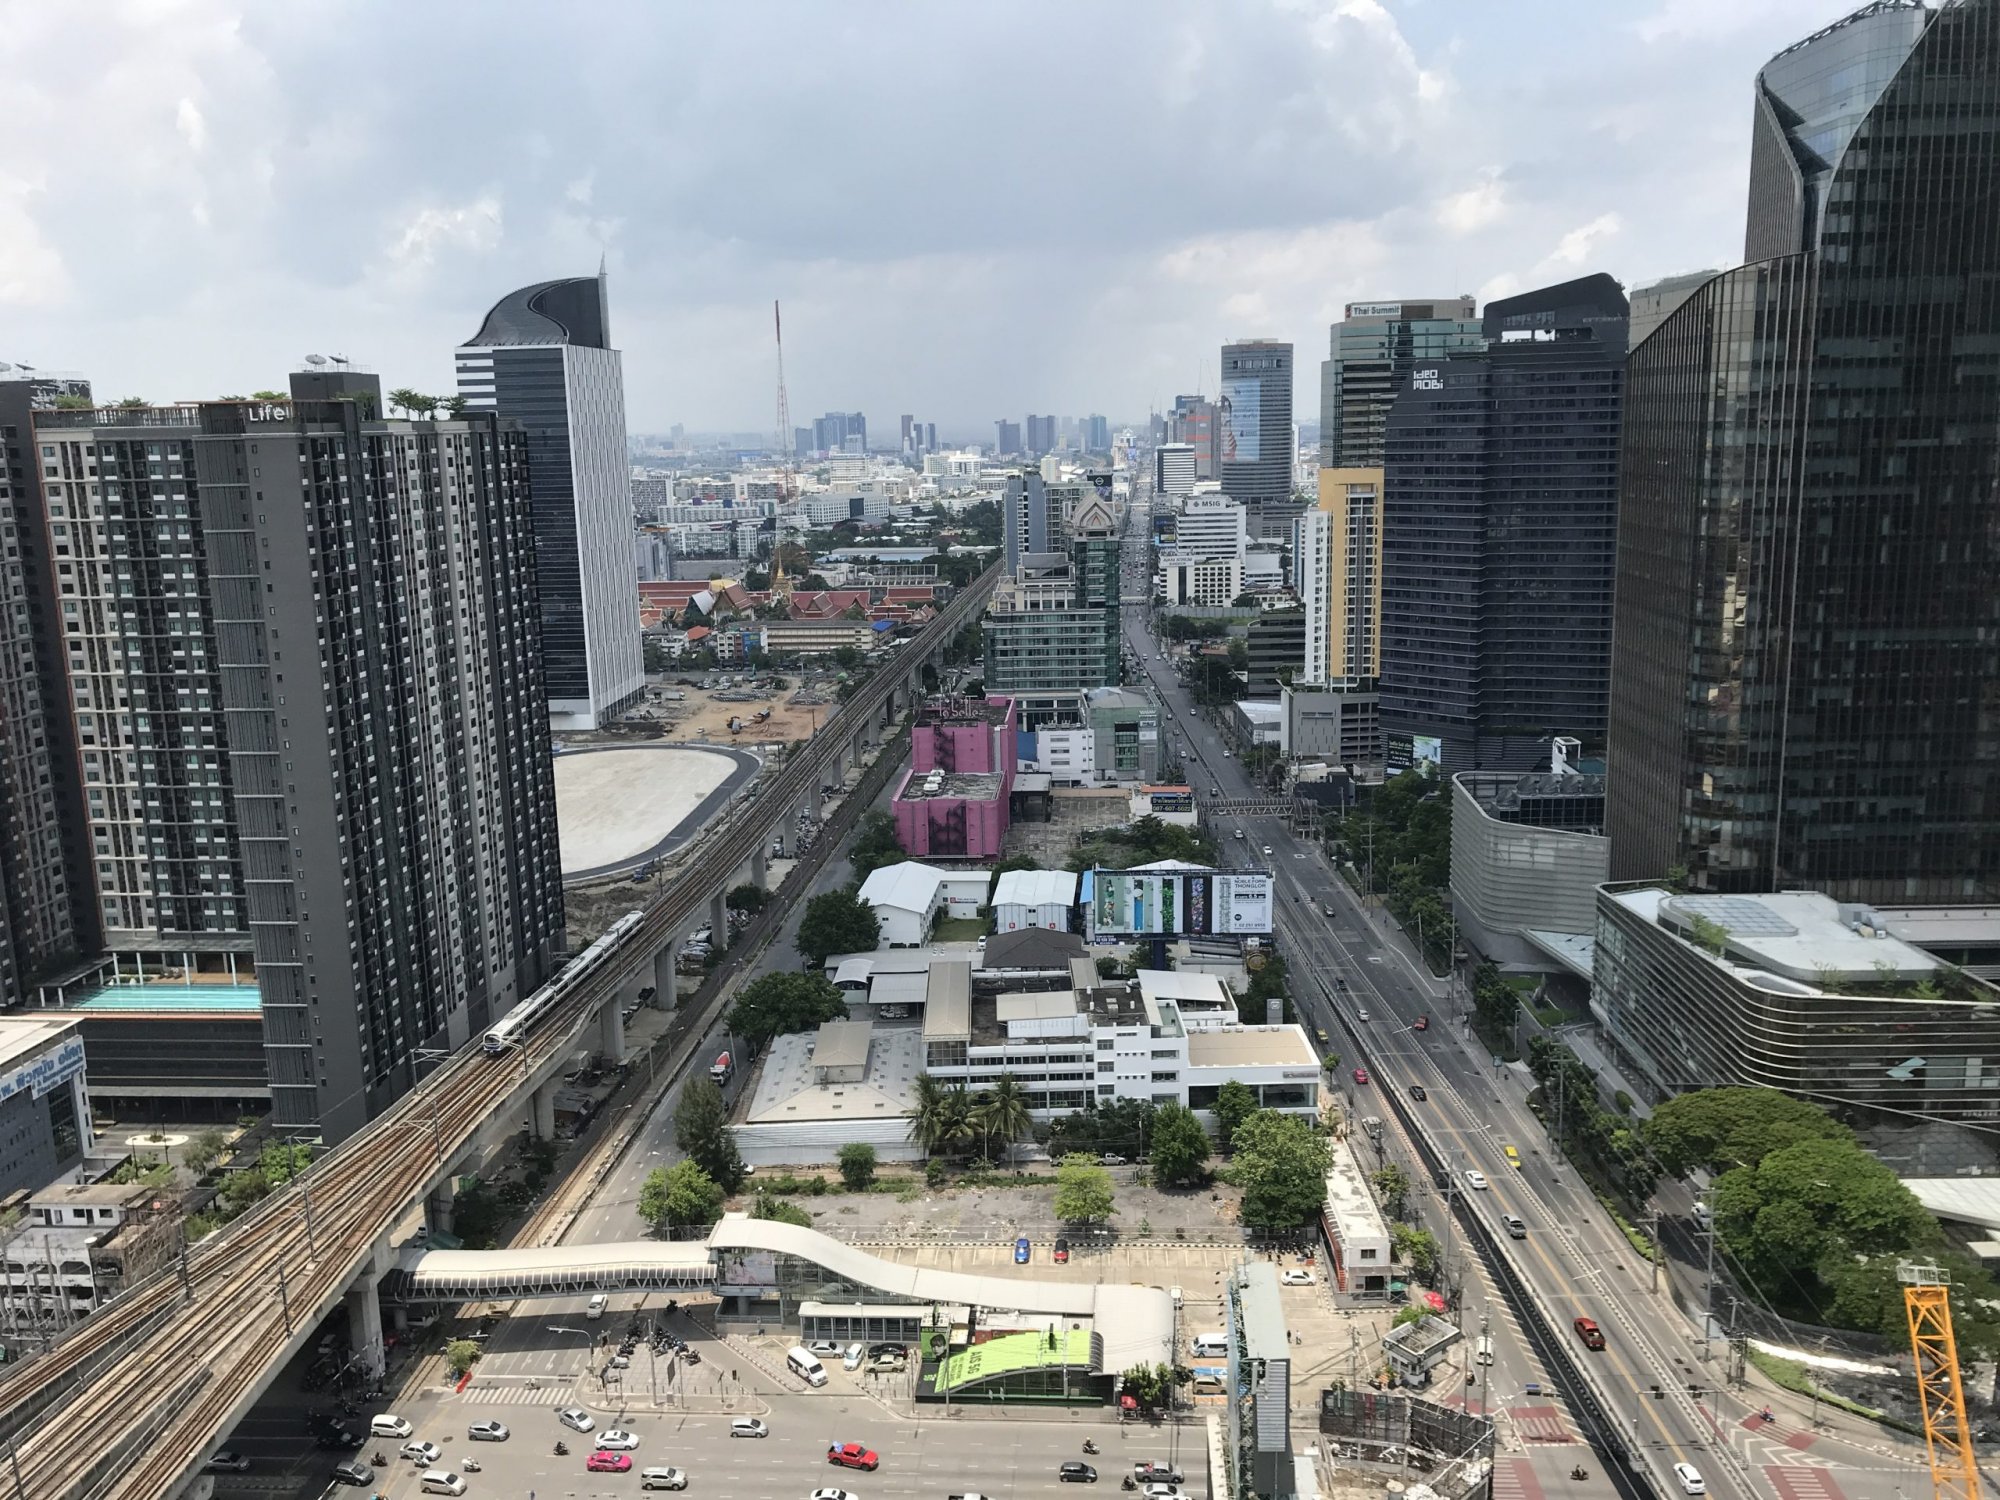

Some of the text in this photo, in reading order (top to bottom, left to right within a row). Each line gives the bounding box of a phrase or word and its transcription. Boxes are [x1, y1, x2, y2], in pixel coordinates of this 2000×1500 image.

[1353, 305, 1400, 315] Thai Summit
[249, 404, 286, 421] Life
[58, 1044, 83, 1065] อโศก
[967, 1351, 982, 1375] AIS 5G
